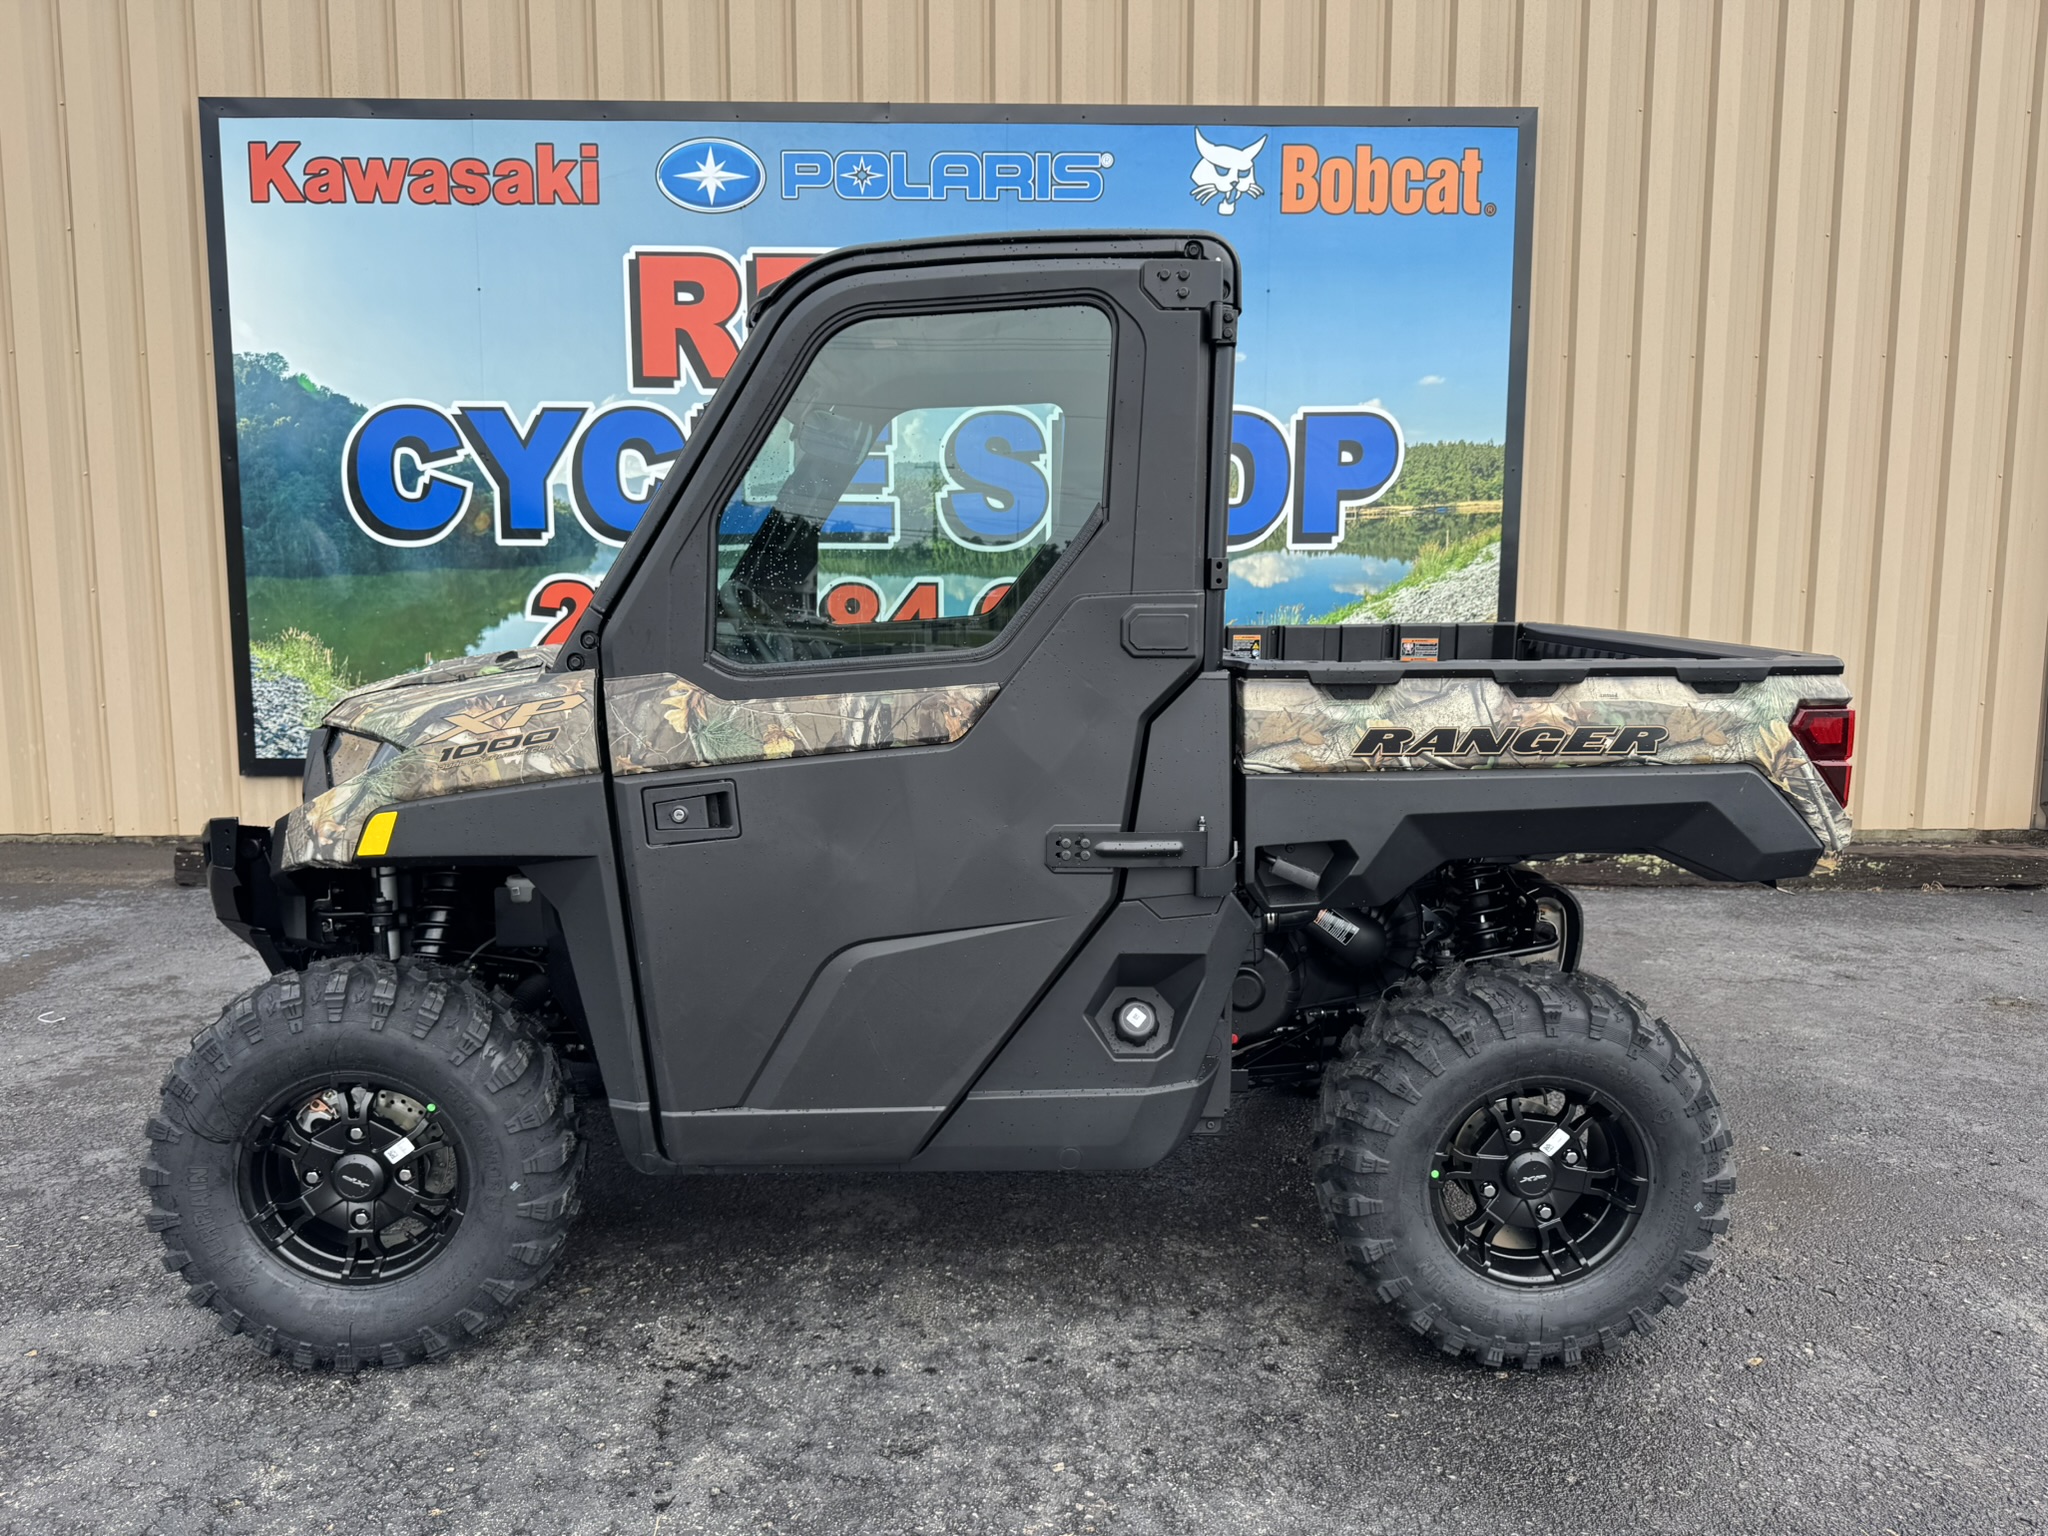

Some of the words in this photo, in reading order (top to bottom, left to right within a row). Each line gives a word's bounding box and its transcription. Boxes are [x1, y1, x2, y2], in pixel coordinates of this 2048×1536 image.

[248, 140, 600, 205] Kawasaki
[780, 150, 1104, 203] POLARIS
[1280, 143, 1483, 216] Bobcat
[418, 694, 588, 746] XP
[439, 727, 561, 763] 1000
[1350, 725, 1670, 757] RANGER
